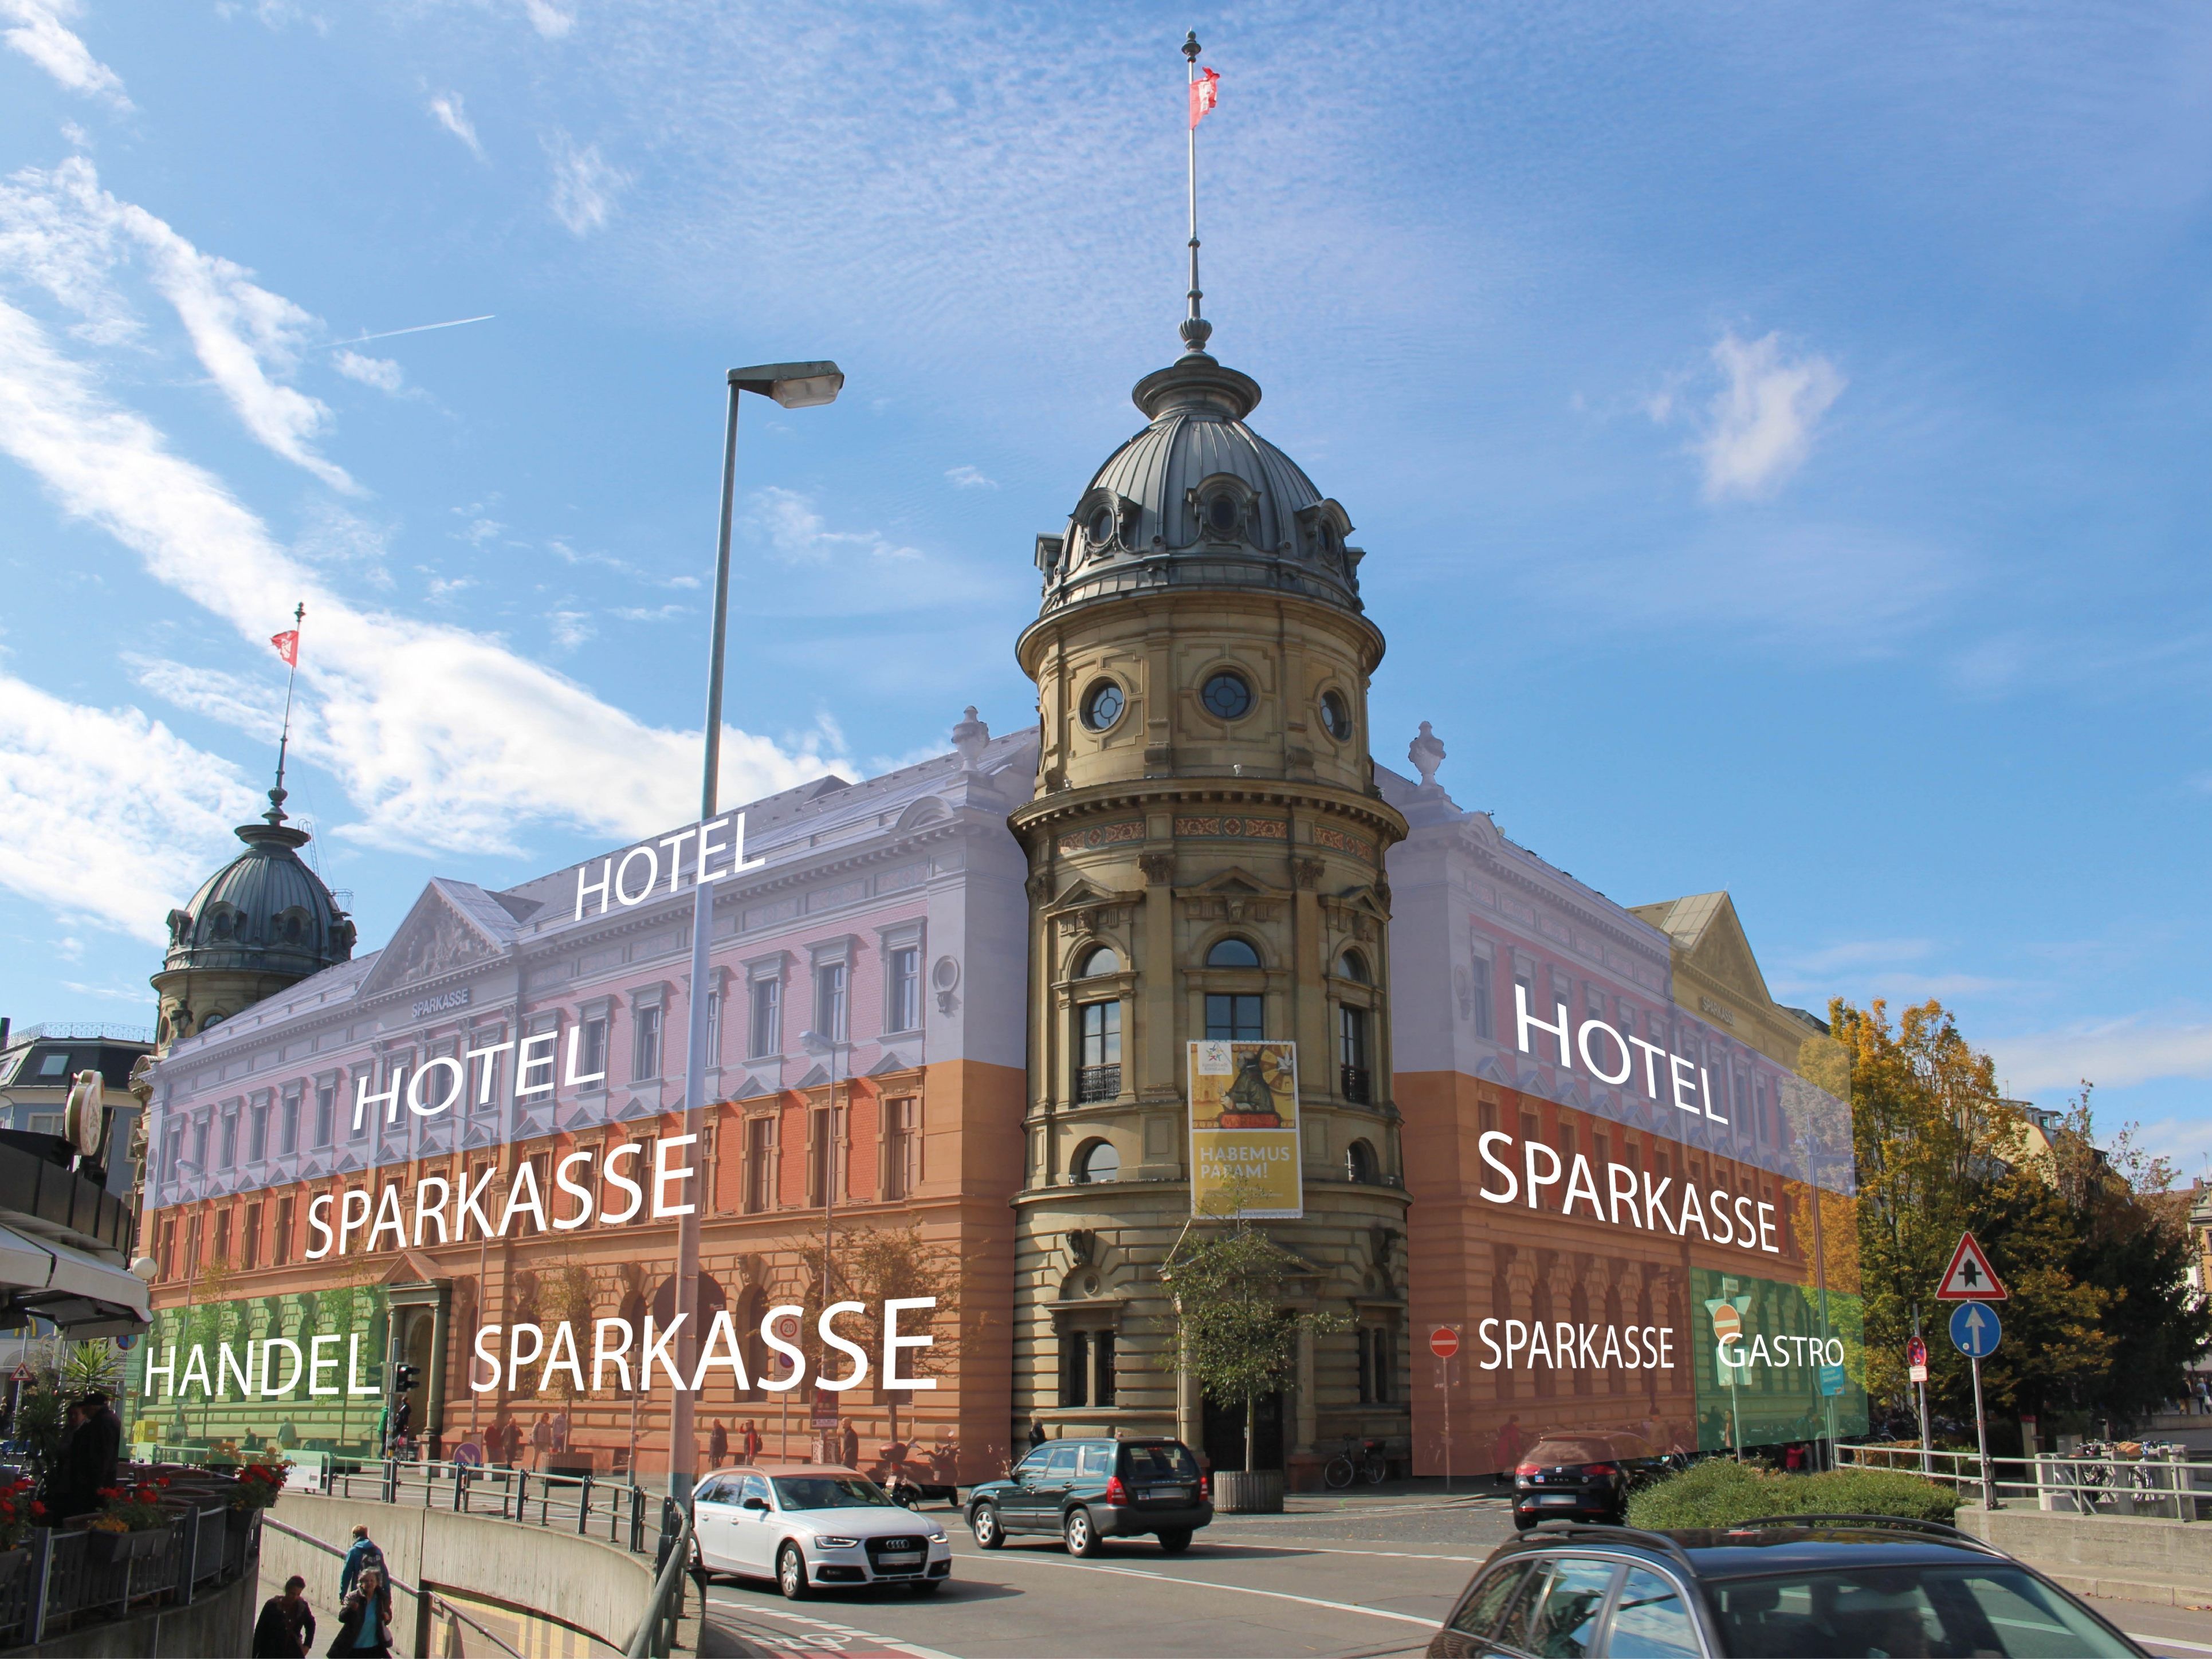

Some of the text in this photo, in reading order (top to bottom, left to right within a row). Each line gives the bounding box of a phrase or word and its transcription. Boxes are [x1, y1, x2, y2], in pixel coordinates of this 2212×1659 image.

[412, 988, 468, 1017] SPARKASSE
[1200, 1146, 1290, 1161] HABEMUS
[1201, 1162, 1268, 1179] PAPAM!
[784, 1323, 794, 1333] 20
